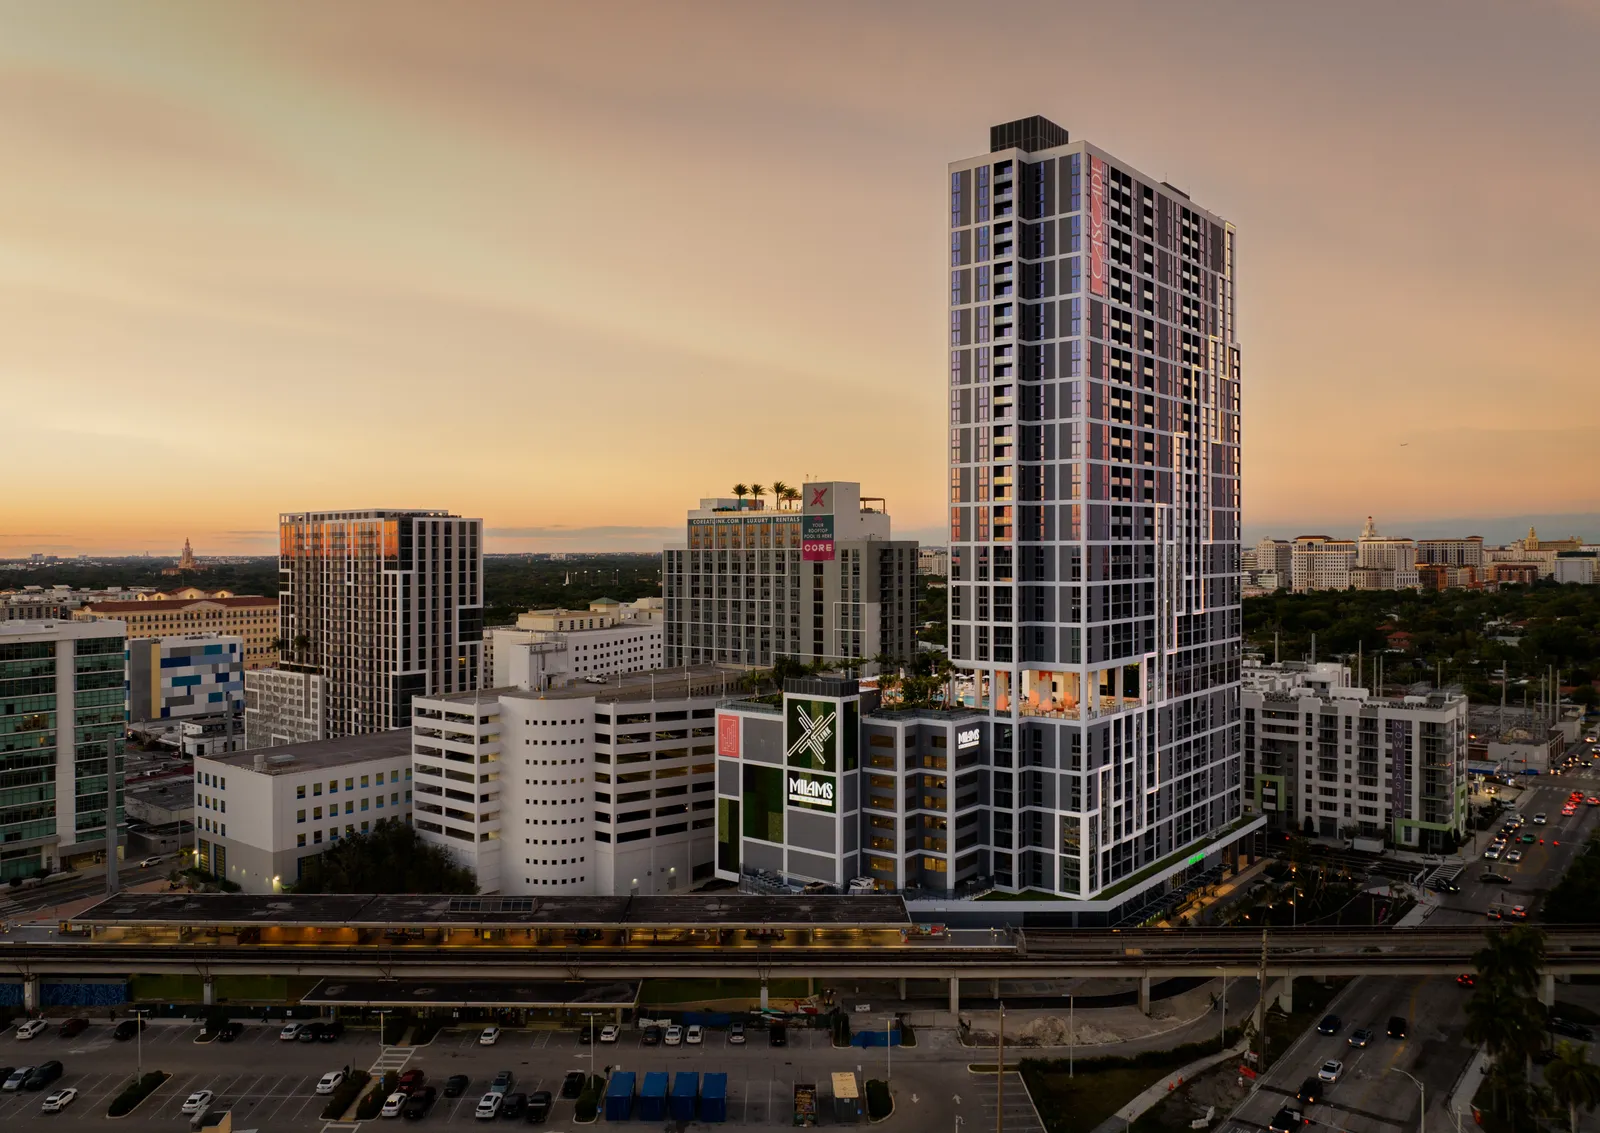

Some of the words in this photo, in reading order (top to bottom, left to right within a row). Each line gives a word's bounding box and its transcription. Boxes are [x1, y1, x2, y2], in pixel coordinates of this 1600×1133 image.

[1092, 162, 1103, 279] CASCADE
[804, 544, 832, 552] CORE
[817, 726, 832, 743] LINK
[1393, 722, 1403, 748] NOW
[1394, 753, 1402, 818] LEASING
